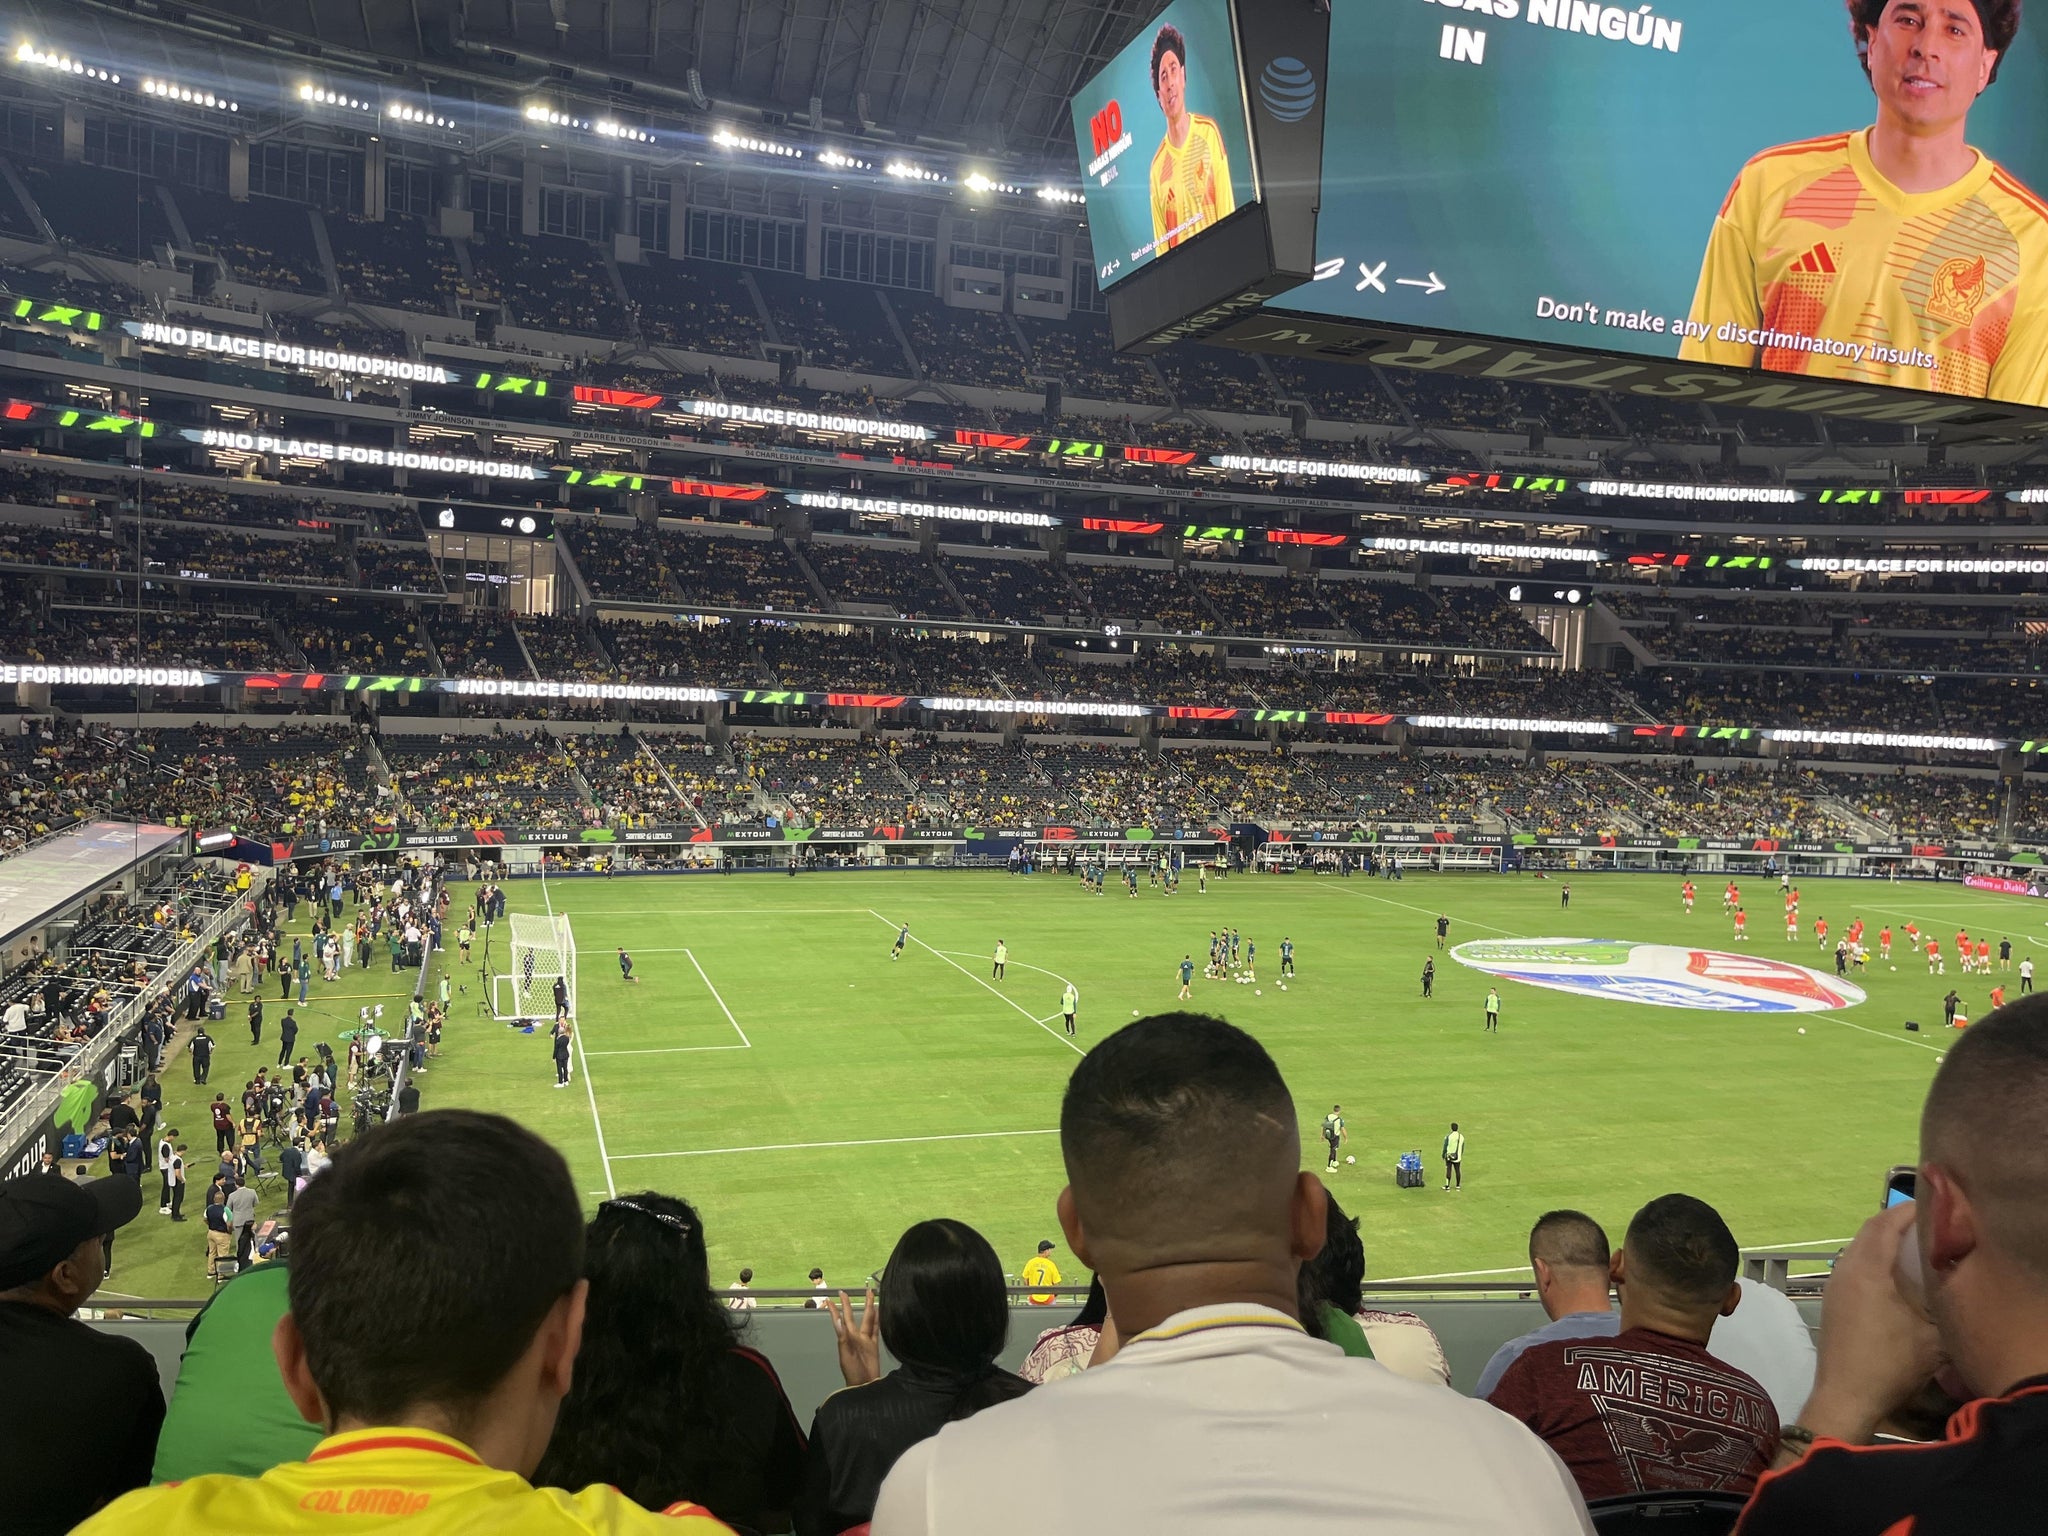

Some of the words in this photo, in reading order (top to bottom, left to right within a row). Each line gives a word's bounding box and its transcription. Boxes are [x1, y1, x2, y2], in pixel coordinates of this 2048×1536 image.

[1526, 0, 1682, 53] NINGÚN
[1439, 24, 1486, 64] IN
[1090, 99, 1122, 157] NO
[1536, 296, 1599, 325] Don't
[1604, 307, 1665, 333] make
[1671, 317, 1711, 342] any
[1716, 320, 1866, 362] discriminatory
[1870, 342, 1939, 370] insults.
[141, 322, 188, 346] #NO
[192, 331, 260, 358] PLACE
[264, 343, 305, 364] FOR
[309, 350, 446, 384] HOMOPHOBIA
[406, 411, 432, 421] JIMMY
[434, 414, 474, 426] JOHNSON
[694, 400, 728, 418] #NO
[731, 405, 784, 425] PLACE
[786, 412, 819, 429] FOR
[821, 416, 927, 441] HOMOPHOBIA
[583, 432, 616, 442] DARREN
[619, 436, 659, 447] WOODSON
[203, 429, 253, 450] #NO
[258, 436, 334, 460] PLACE
[338, 446, 384, 465] FOR
[388, 452, 535, 480] HOMOPHOBIA
[755, 452, 789, 461] CHARLES
[790, 455, 814, 463] HALEY
[1221, 455, 1250, 470] #NO
[1252, 458, 1296, 474] PLACE
[1299, 461, 1327, 476] FOR
[1328, 463, 1421, 482] HOMOPHOBIA
[1589, 481, 1619, 496] #NO
[1620, 483, 1664, 498] PLACE
[1666, 485, 1694, 500] FOR
[1695, 487, 1795, 503] HOMOPHOBIA
[800, 493, 838, 509] #NO
[841, 497, 897, 515] PLACE
[901, 502, 935, 518] FOR
[937, 505, 1052, 527] HOMOPHOBIA
[1374, 537, 1407, 551] #NO
[1410, 540, 1458, 555] PLACE
[1462, 542, 1492, 556] FOR
[1494, 544, 1598, 562] HOMOPHOBIA
[1801, 558, 1839, 571] #NO
[1843, 559, 1902, 572] PLACE
[1905, 559, 1943, 573] FOR
[1946, 560, 2048, 574] HOMOPHO
[21, 666, 61, 684] FOR
[64, 667, 204, 686] HOMOPHOBIA
[457, 679, 497, 695] #NO
[501, 682, 559, 697] PLACE
[563, 683, 598, 698] FOR
[601, 684, 718, 702] HOMOPHOBIA
[933, 698, 963, 711] #NO
[966, 699, 1013, 713] PLACE
[1016, 700, 1043, 713] FOR
[1046, 701, 1141, 717] HOMOPHOBIA
[1418, 715, 1445, 728] #NO
[1447, 716, 1490, 730] PLACE
[1492, 718, 1518, 730] FOR
[1520, 719, 1608, 734] HOMOPHOBIA
[1773, 729, 1801, 742] #NO
[1803, 730, 1850, 744] PLACE
[1853, 733, 1884, 746] FOR
[1886, 733, 1995, 751] HOMOPHOBIA
[331, 840, 350, 849] AT&T
[1184, 830, 1200, 838] AT&T
[1037, 1269, 1045, 1286] 7
[299, 1488, 432, 1516] COLOMBIA
